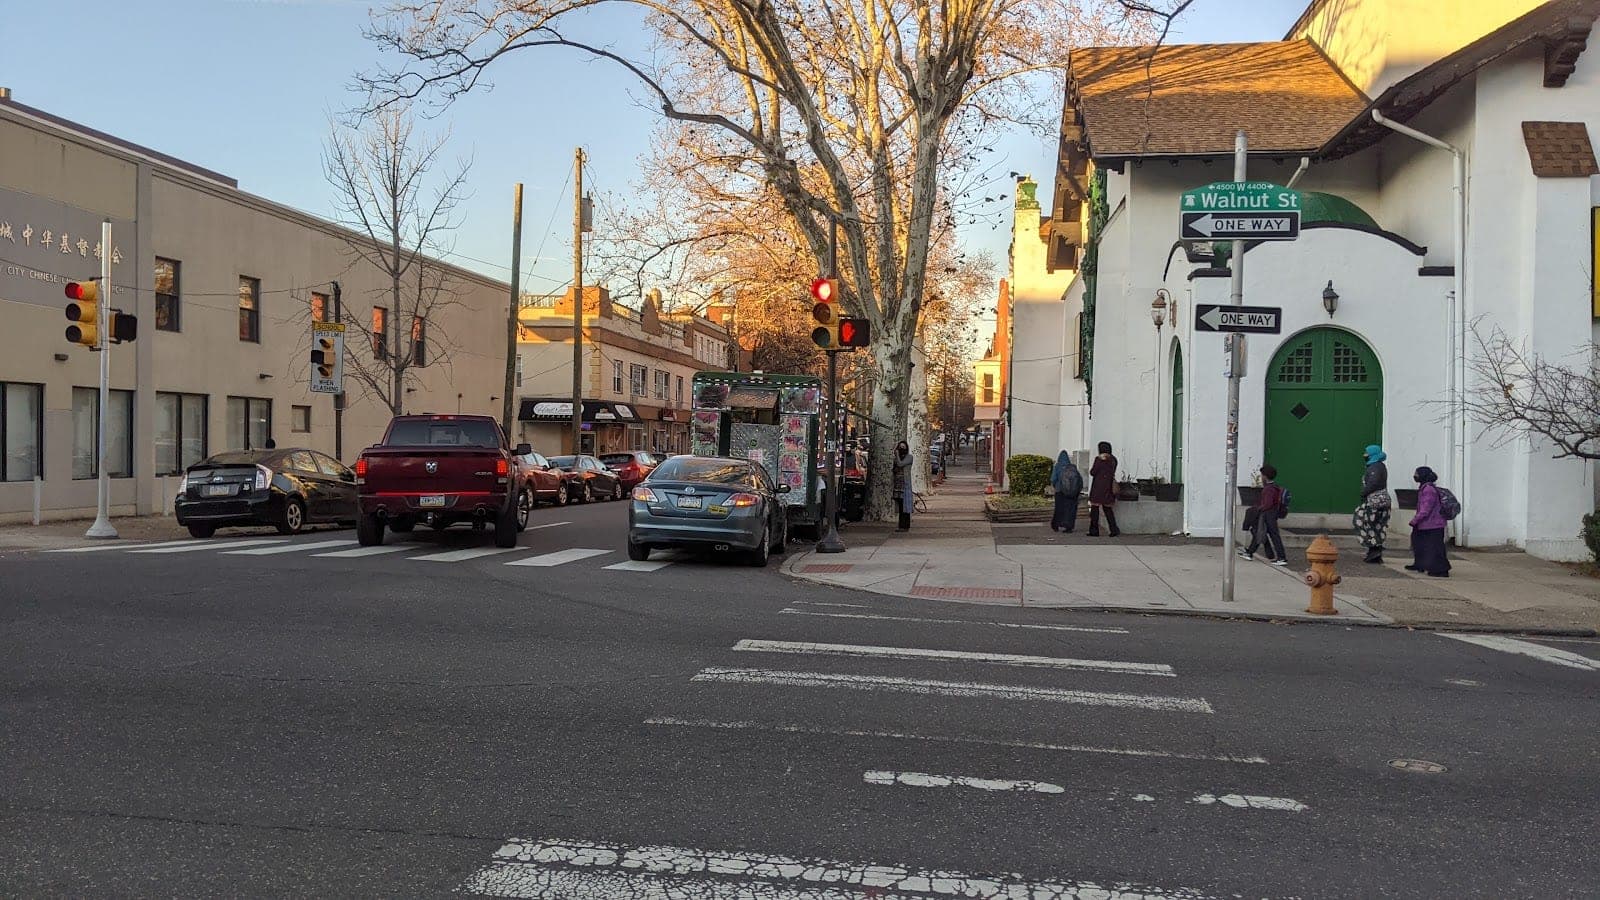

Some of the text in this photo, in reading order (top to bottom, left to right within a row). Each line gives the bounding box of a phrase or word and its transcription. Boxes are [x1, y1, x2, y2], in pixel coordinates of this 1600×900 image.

[1236, 183, 1245, 191] W
[1201, 192, 1298, 208] Walnut St
[1214, 219, 1284, 230] ONE WAY
[7, 266, 26, 277] CITY
[29, 270, 58, 283] CHINESE
[1220, 313, 1273, 326] ONE WAY
